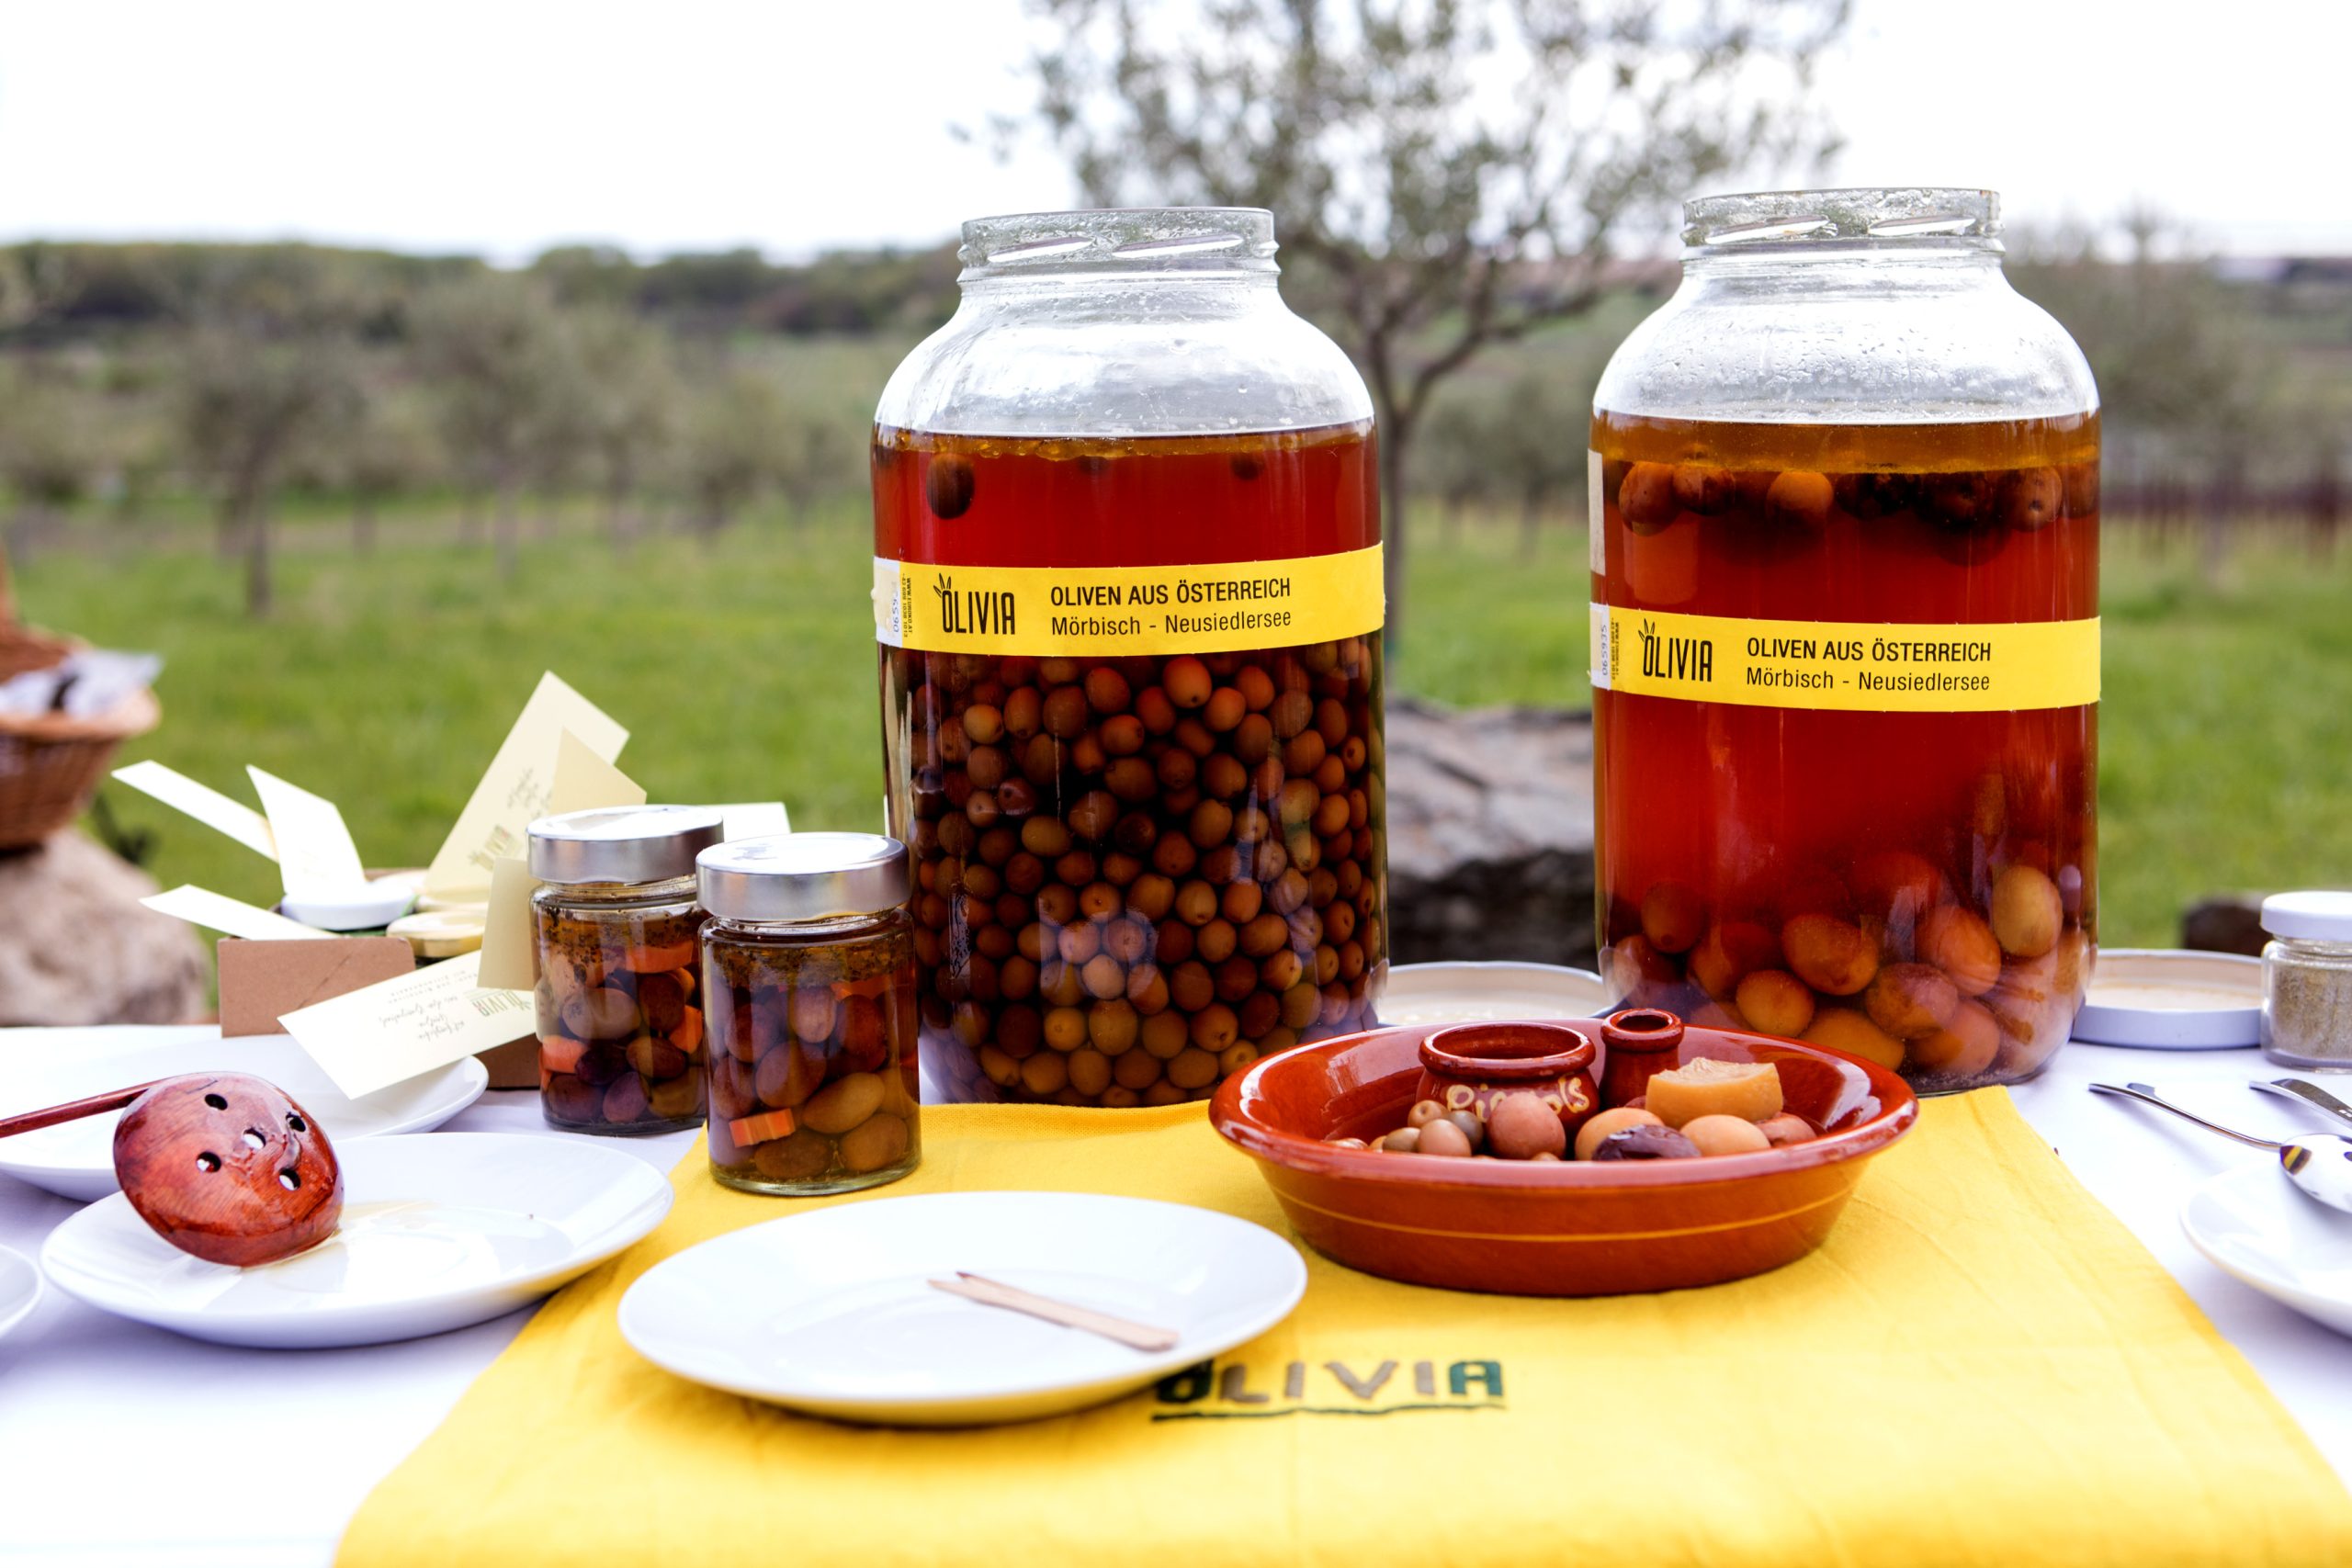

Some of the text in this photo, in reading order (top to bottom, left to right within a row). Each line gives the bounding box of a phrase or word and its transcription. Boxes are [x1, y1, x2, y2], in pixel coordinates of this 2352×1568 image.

[1050, 578, 1291, 606] OLIVEN AUS ÖSTERREICH
[942, 590, 1015, 635] OLIVIA
[1050, 615, 1141, 636] Mörbisch
[1165, 611, 1292, 634] Neusiedlersee
[1643, 635, 1713, 682] OLIVIA
[1747, 637, 1992, 662] OLIVEN AUS ÖSTERREICH
[1746, 667, 1834, 689] Mörbisch
[1859, 671, 1991, 691] Neusiedlersee
[1156, 1359, 1504, 1404] OLIVIA
